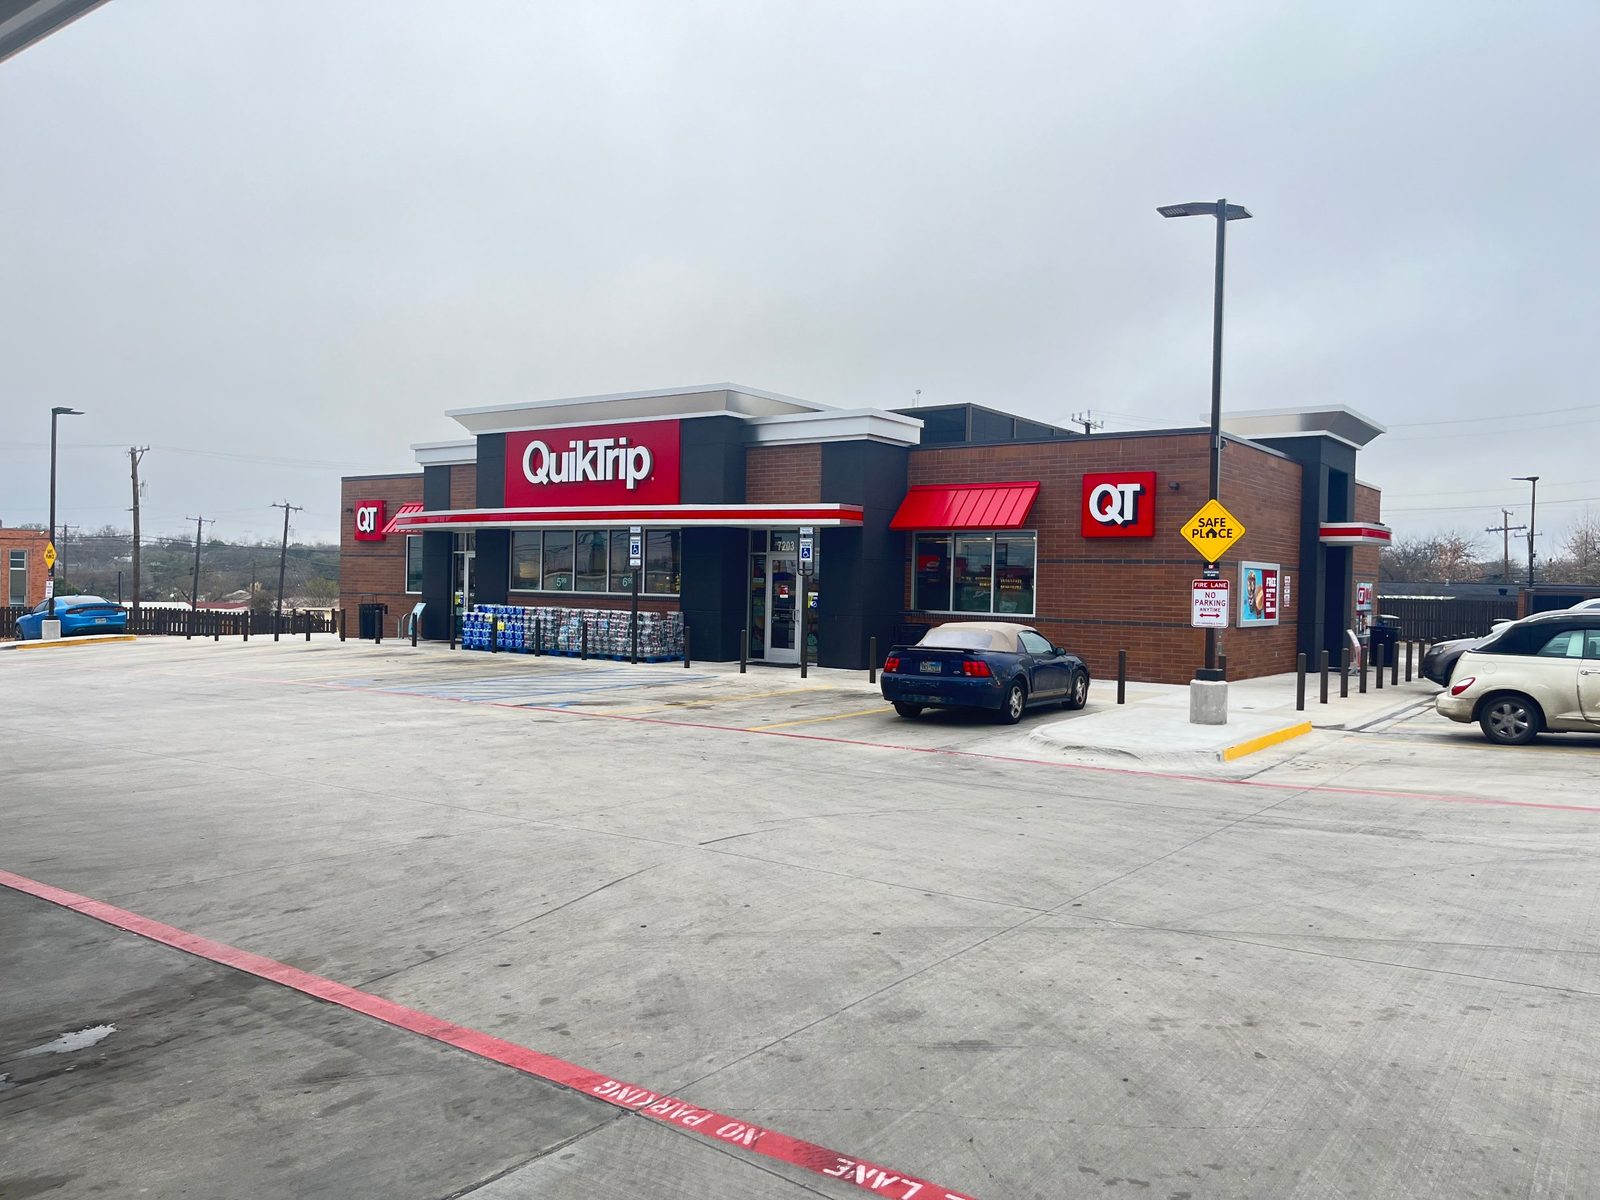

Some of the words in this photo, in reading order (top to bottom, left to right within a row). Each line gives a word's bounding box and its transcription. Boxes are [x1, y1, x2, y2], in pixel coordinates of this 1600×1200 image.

[522, 437, 652, 490] QuikTrip
[1088, 483, 1141, 525] QT
[357, 507, 377, 533] QT
[1198, 518, 1226, 527] SAFE
[777, 541, 795, 551] 7203
[1194, 599, 1226, 607] PARKING
[594, 1080, 714, 1127] PARKING
[715, 1122, 766, 1147] NO
[822, 1157, 925, 1200] LANE
